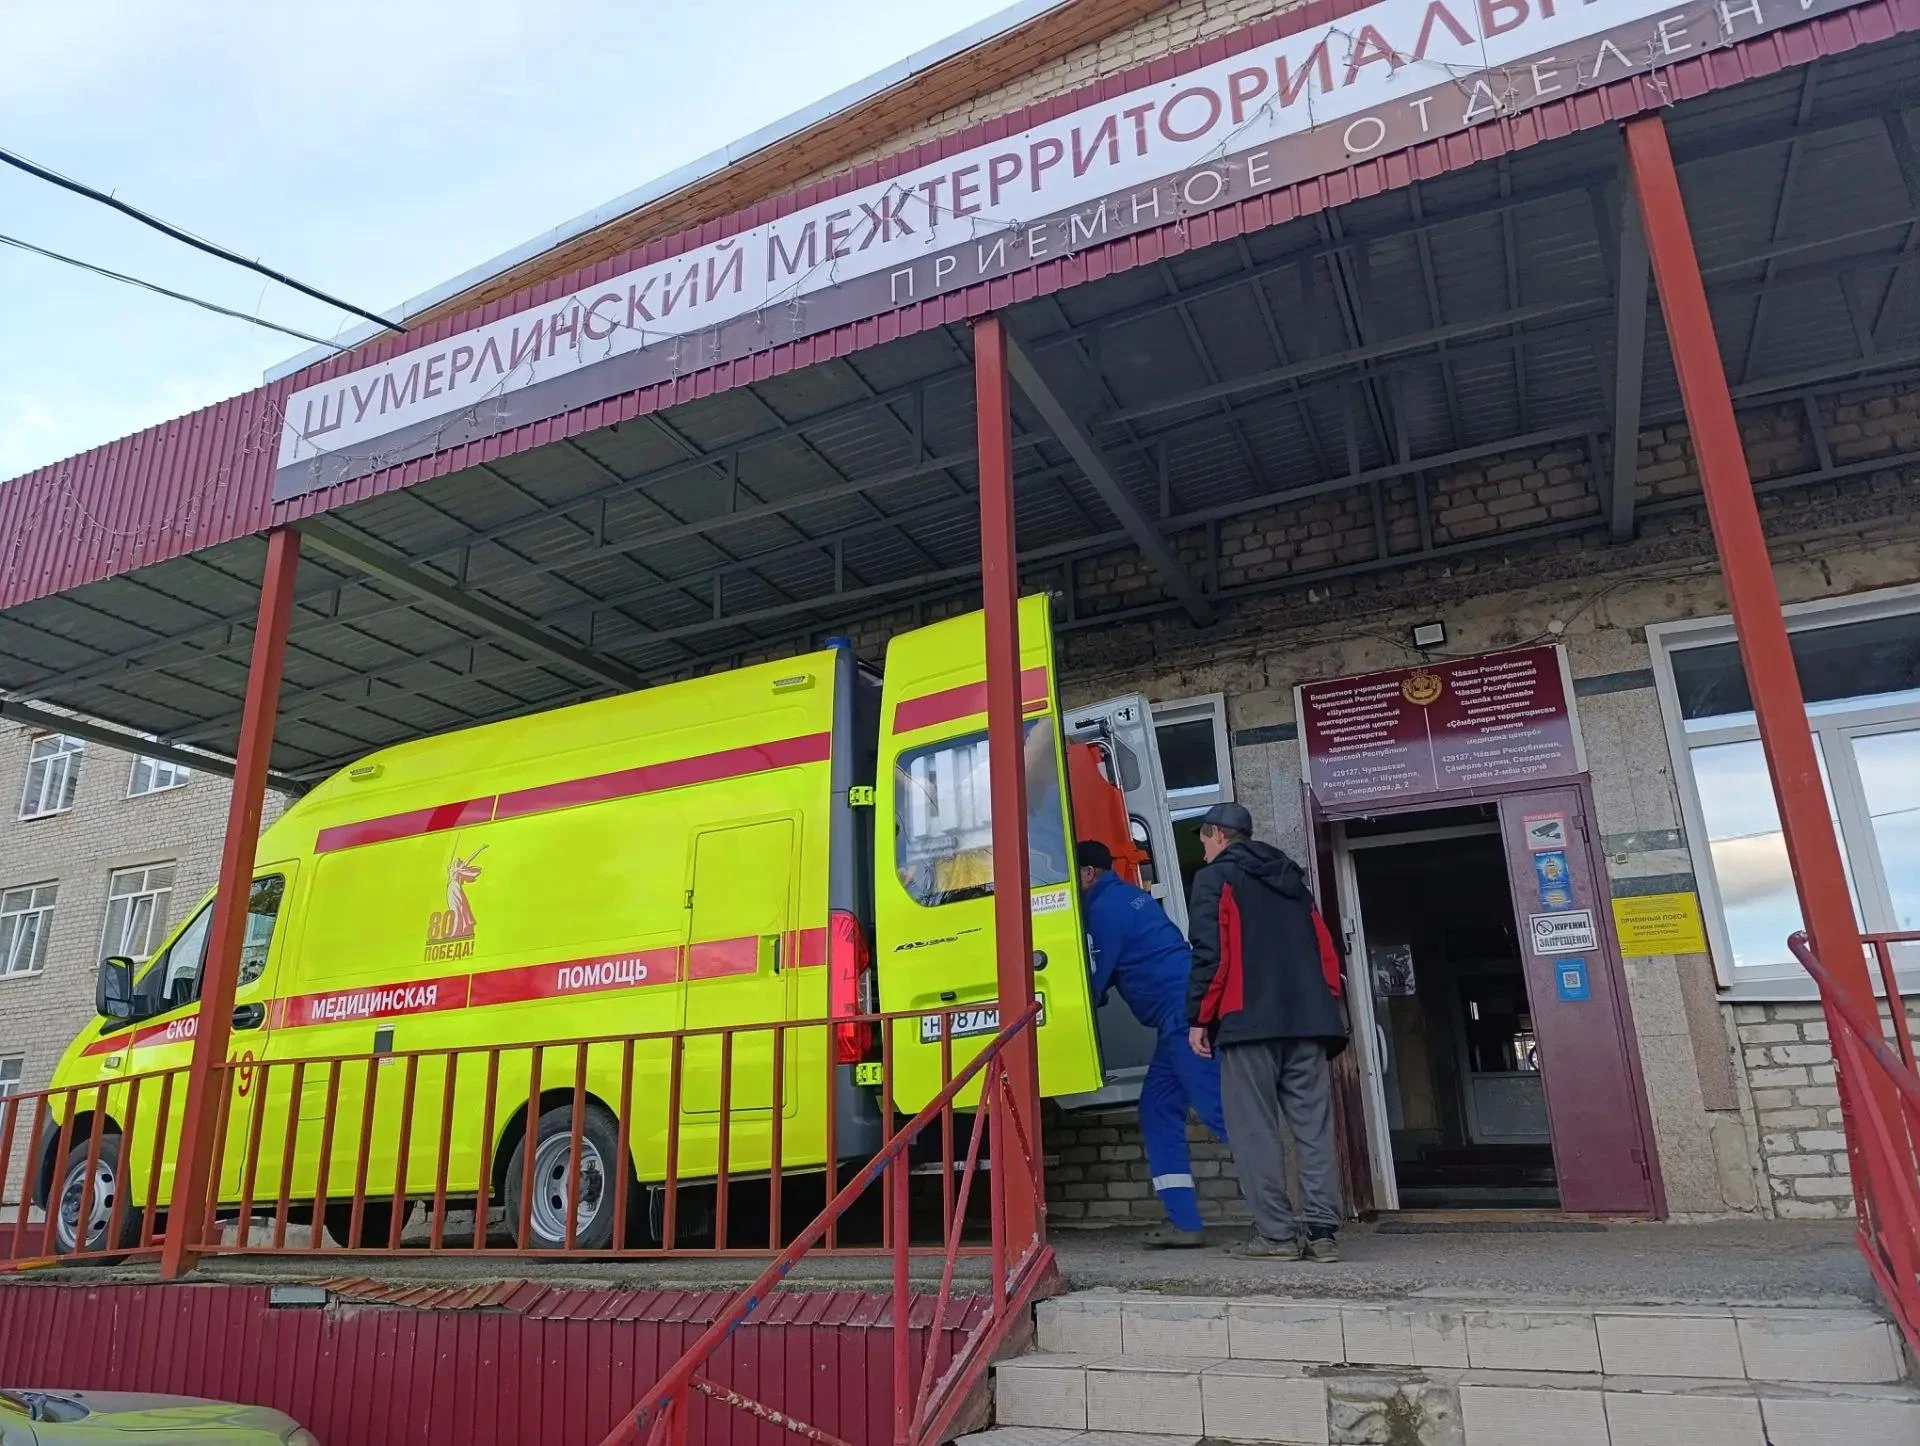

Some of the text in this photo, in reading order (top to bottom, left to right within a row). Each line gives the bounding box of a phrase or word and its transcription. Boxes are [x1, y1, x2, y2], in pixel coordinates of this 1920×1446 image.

[890, 0, 1814, 304] ПРИЕМНОЕ ОТДЕЛЕН
[303, 239, 744, 440] ШУМЕРЛИНСКИЙ
[1480, 660, 1532, 673] Республикин
[1451, 679, 1481, 688] бюджет
[1483, 680, 1536, 692] Республикин
[1311, 682, 1399, 701] Бюджетное учреждение
[1312, 691, 1400, 710] Чувашской Республики
[1468, 701, 1530, 714] министерствин
[1497, 707, 1556, 720] территорисем
[1317, 709, 1400, 727] межтерриториальный
[1321, 723, 1370, 735] медицинский
[1334, 730, 1387, 743] Министерства
[1467, 735, 1507, 745] медицина
[1329, 739, 1395, 753] здравоохранения
[1319, 746, 1408, 766] Чувашской Республики
[1513, 752, 1561, 763] Свердлова
[1362, 763, 1405, 773] Чувашская
[1554, 921, 1586, 931] КУРЕНИЕ
[1539, 935, 1590, 947] ЗАПРЕЩЕНО!
[424, 941, 474, 962] ПОБЕДА!
[312, 985, 438, 1020] МЕДИЦИНСКАЯ
[557, 958, 648, 990] ПОМОЩЬ
